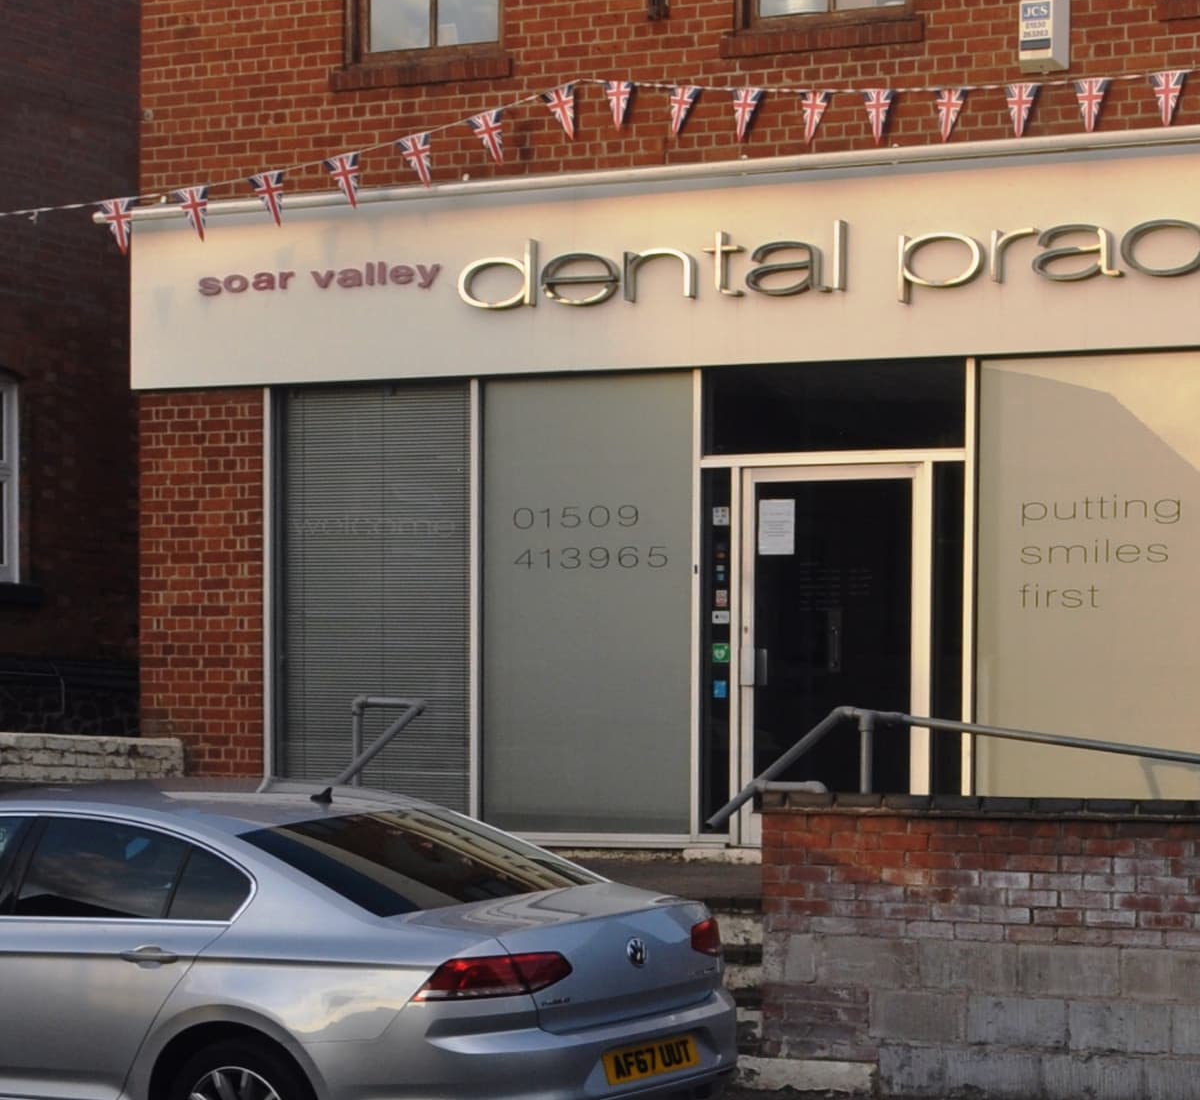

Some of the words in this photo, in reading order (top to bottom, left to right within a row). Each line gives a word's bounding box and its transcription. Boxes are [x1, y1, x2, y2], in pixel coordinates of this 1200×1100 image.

[1024, 5, 1048, 17] JCS
[198, 271, 295, 296] soar
[311, 261, 441, 290] valley
[458, 219, 848, 310] dental
[513, 504, 640, 530] 01509
[1021, 494, 1181, 527] putting
[513, 546, 669, 570] 413965
[1020, 539, 1169, 565] smiles
[1019, 584, 1100, 609] first
[614, 1046, 656, 1079] AF67
[659, 1040, 691, 1067] UUT
